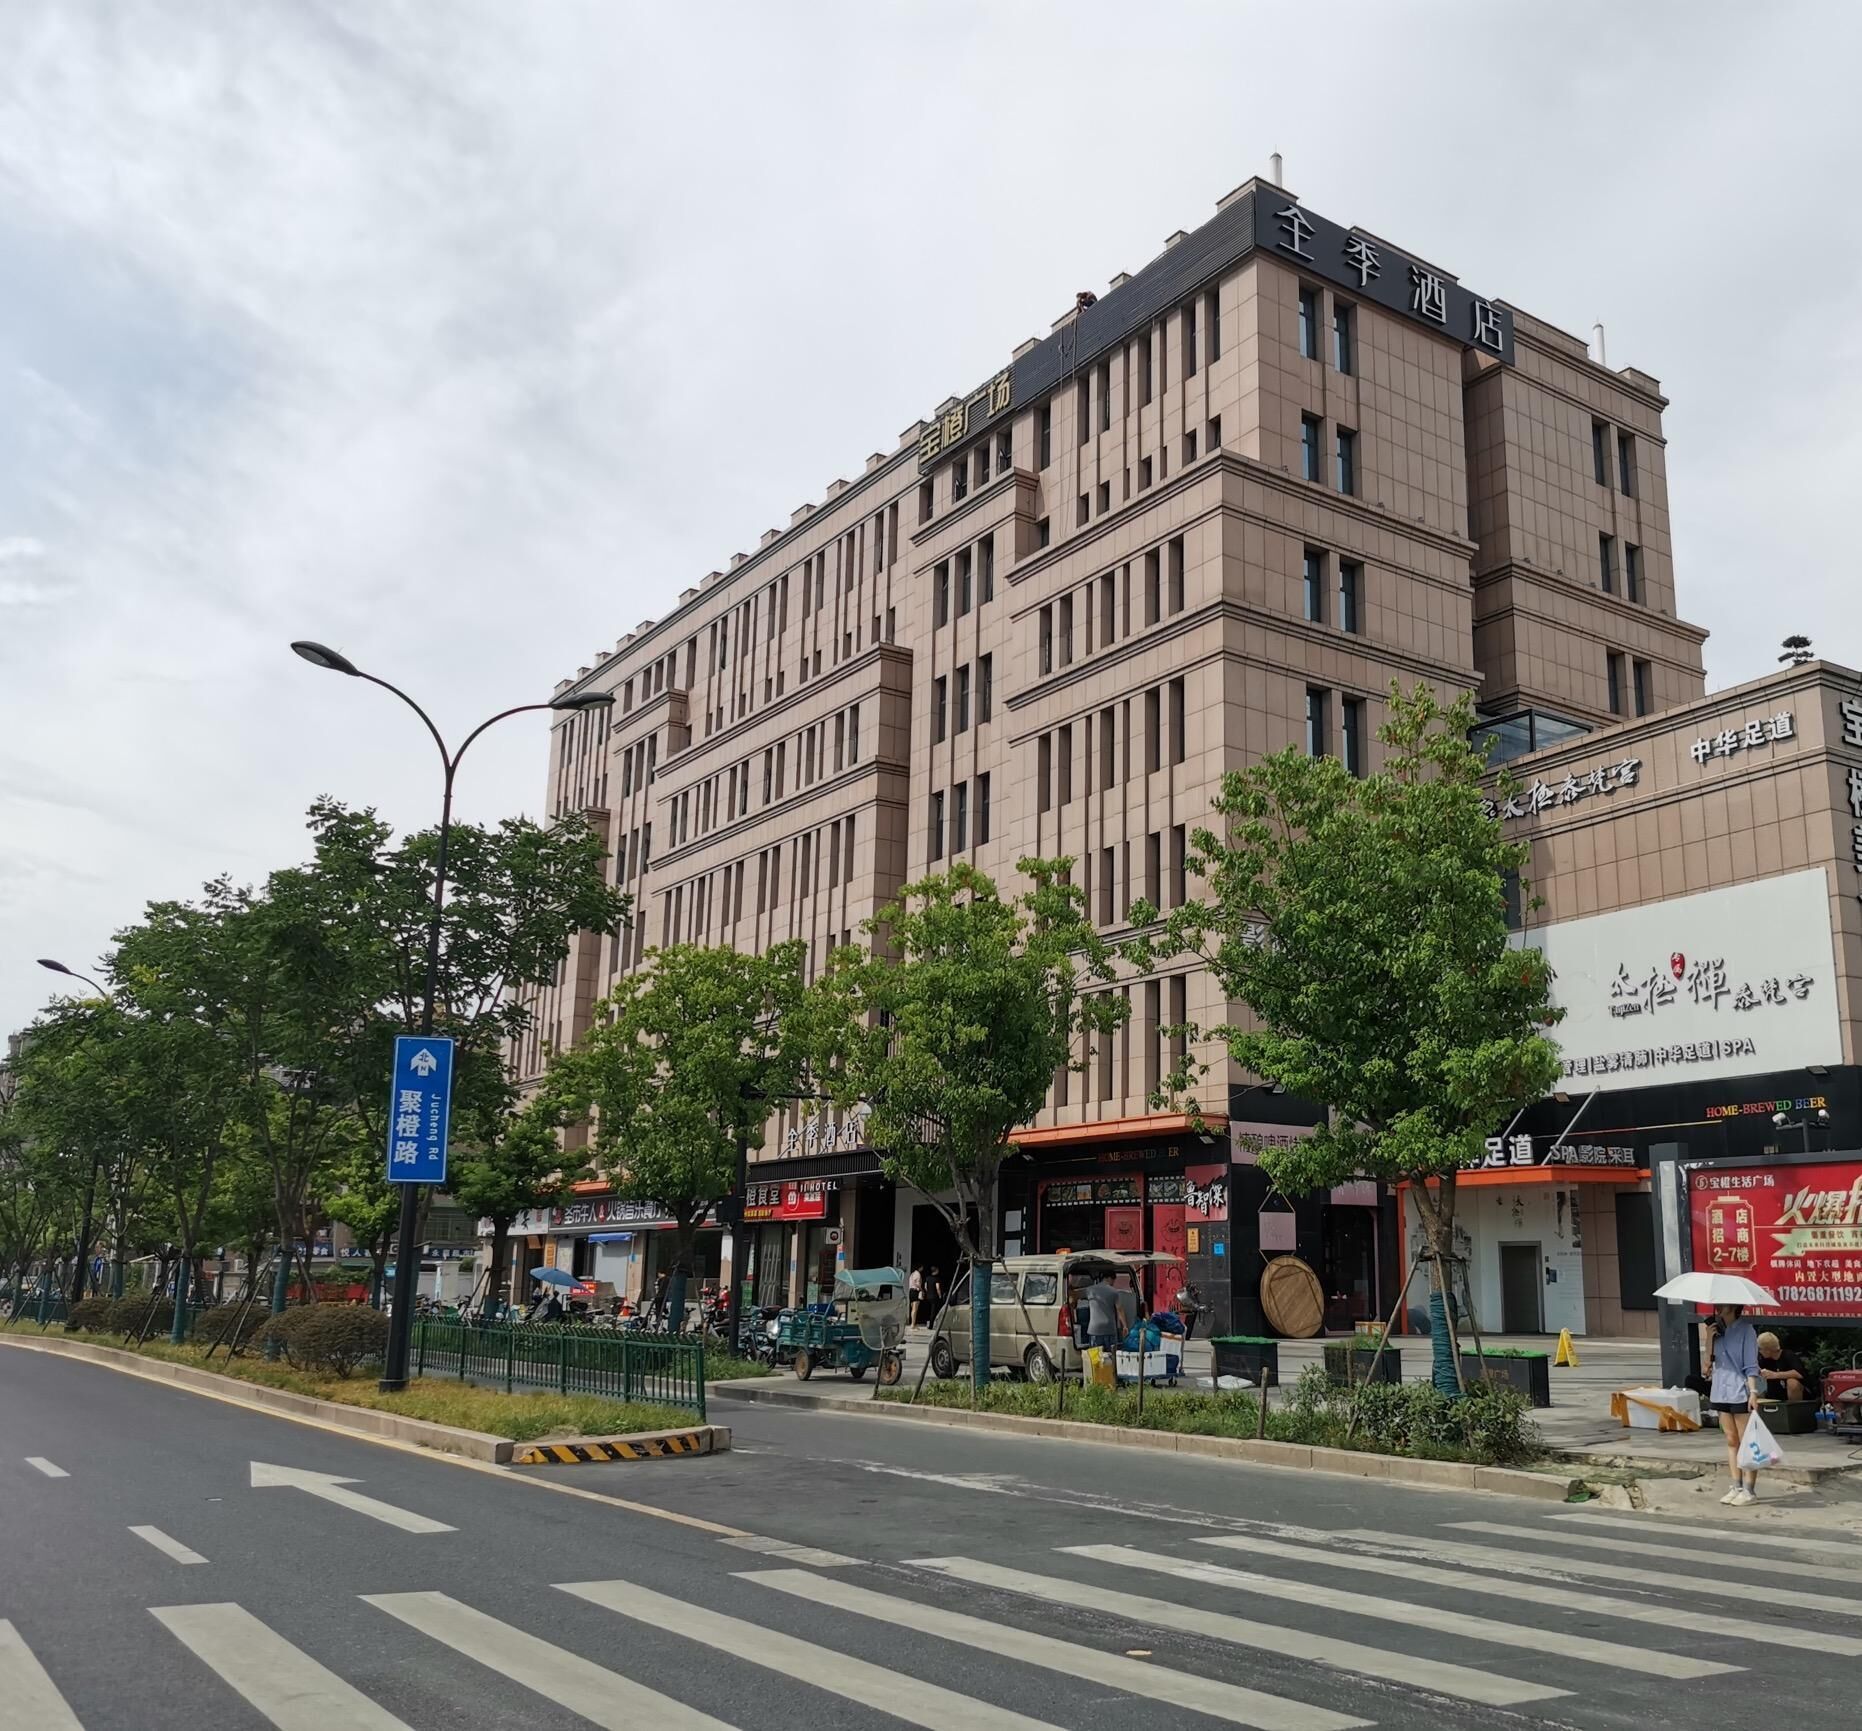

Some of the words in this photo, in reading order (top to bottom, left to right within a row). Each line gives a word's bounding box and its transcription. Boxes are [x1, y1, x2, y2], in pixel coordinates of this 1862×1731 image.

[1276, 205, 1503, 352] 全季酒店
[919, 372, 1010, 465] 宝橙广场
[1691, 711, 1794, 763] 中华足道
[419, 1052, 429, 1063] 北
[420, 1064, 427, 1072] N
[426, 1093, 441, 1140] Jucheng
[1706, 1100, 1792, 1118] HOME-BREWED
[1795, 1096, 1827, 1110] BEER
[393, 1089, 423, 1165] 聚橙路
[428, 1147, 439, 1160] Rd
[810, 1180, 838, 1192] HOTEL
[1710, 1174, 1775, 1189] 宝橙生活广场
[1184, 1181, 1224, 1216] 鲁智深
[1713, 1247, 1749, 1262] 2-7楼
